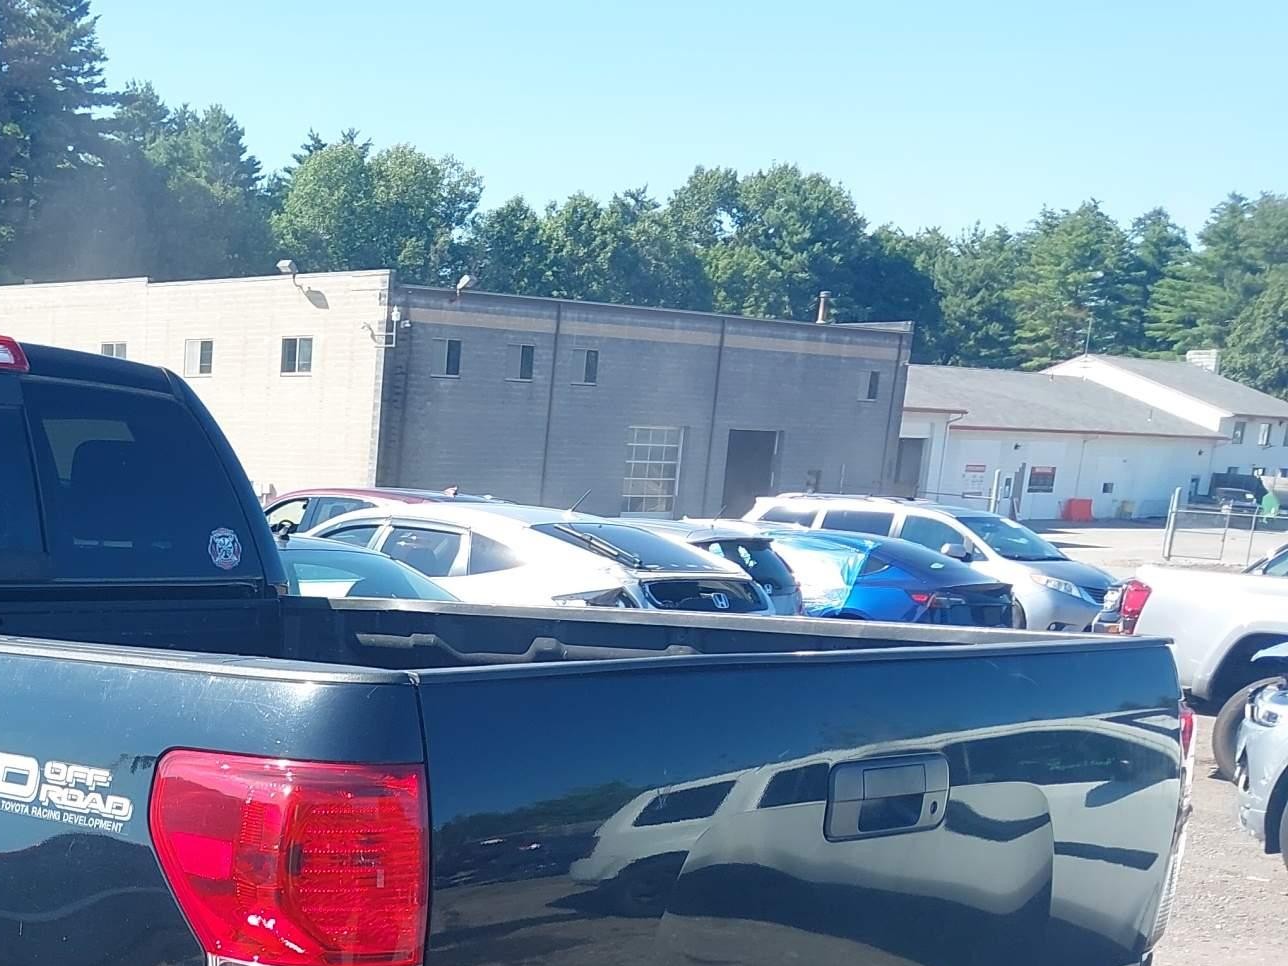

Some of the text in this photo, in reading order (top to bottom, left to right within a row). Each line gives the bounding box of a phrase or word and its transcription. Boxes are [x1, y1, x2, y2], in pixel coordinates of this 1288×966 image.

[43, 760, 113, 790] OFF
[1, 800, 124, 833] TOYOTA RACING DEVELOPMENT
[38, 783, 134, 821] ROAD
